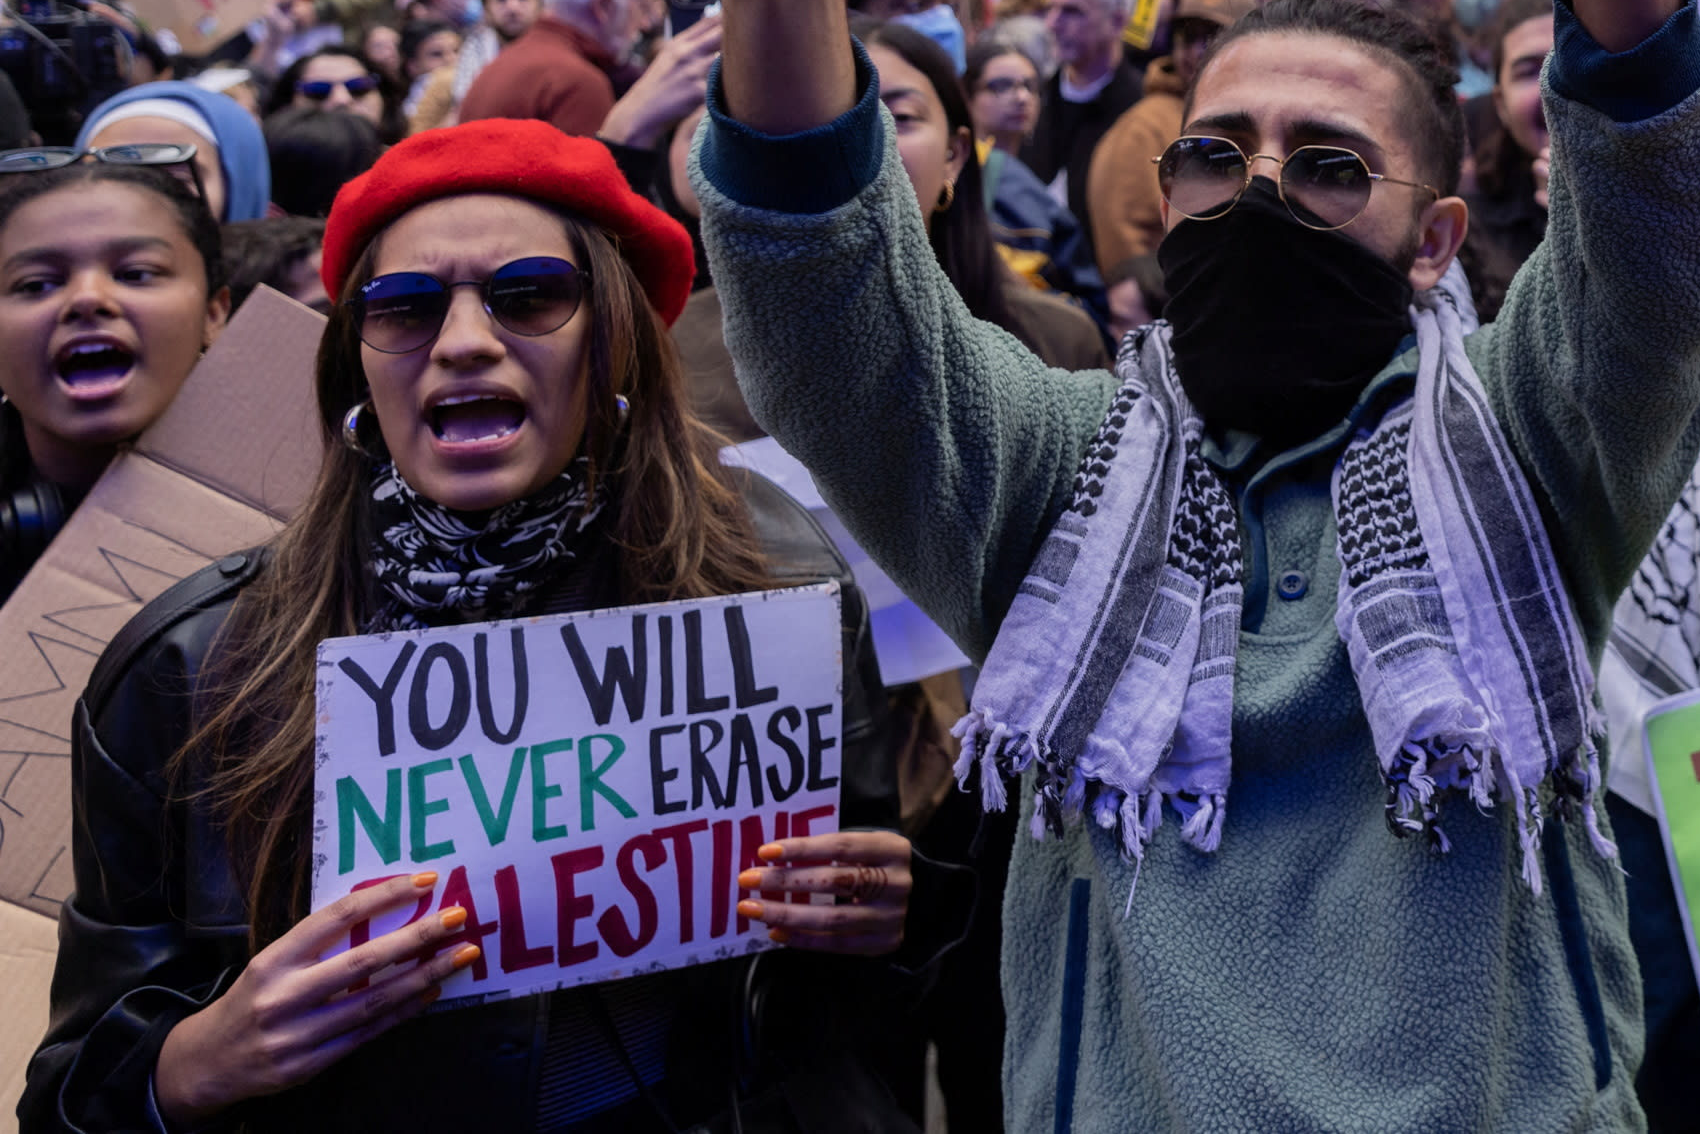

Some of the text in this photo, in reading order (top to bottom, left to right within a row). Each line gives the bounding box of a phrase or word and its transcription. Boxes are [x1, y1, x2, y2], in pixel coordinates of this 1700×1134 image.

[338, 606, 779, 757] YOU WILL
[335, 704, 840, 875] NEVER ERASE
